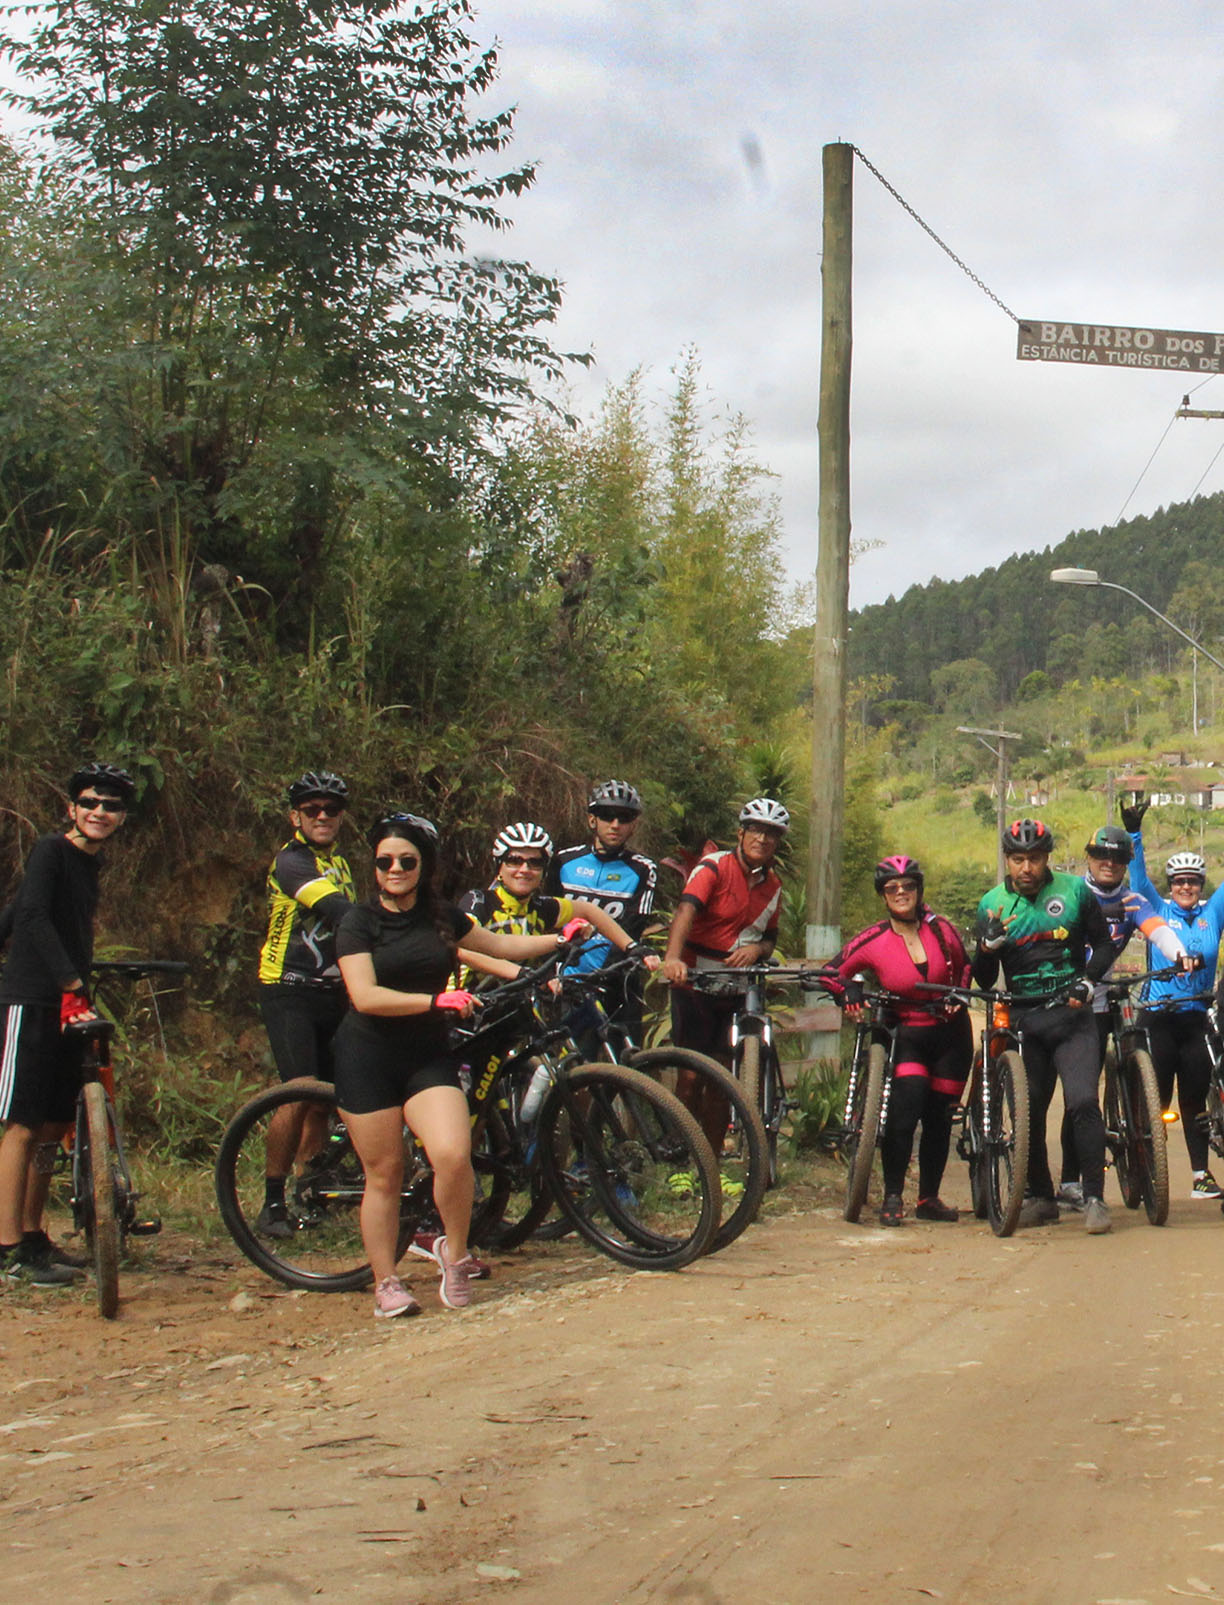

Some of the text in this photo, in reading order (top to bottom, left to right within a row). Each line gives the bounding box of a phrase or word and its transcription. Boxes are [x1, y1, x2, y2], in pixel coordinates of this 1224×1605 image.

[1040, 323, 1154, 349] BAIRRO
[1166, 337, 1205, 354] DOS
[1021, 344, 1099, 362] ESTÂNCIA
[1105, 351, 1190, 368] TURÍSTICA
[1199, 357, 1220, 371] DE
[475, 1055, 501, 1100] CALOI
